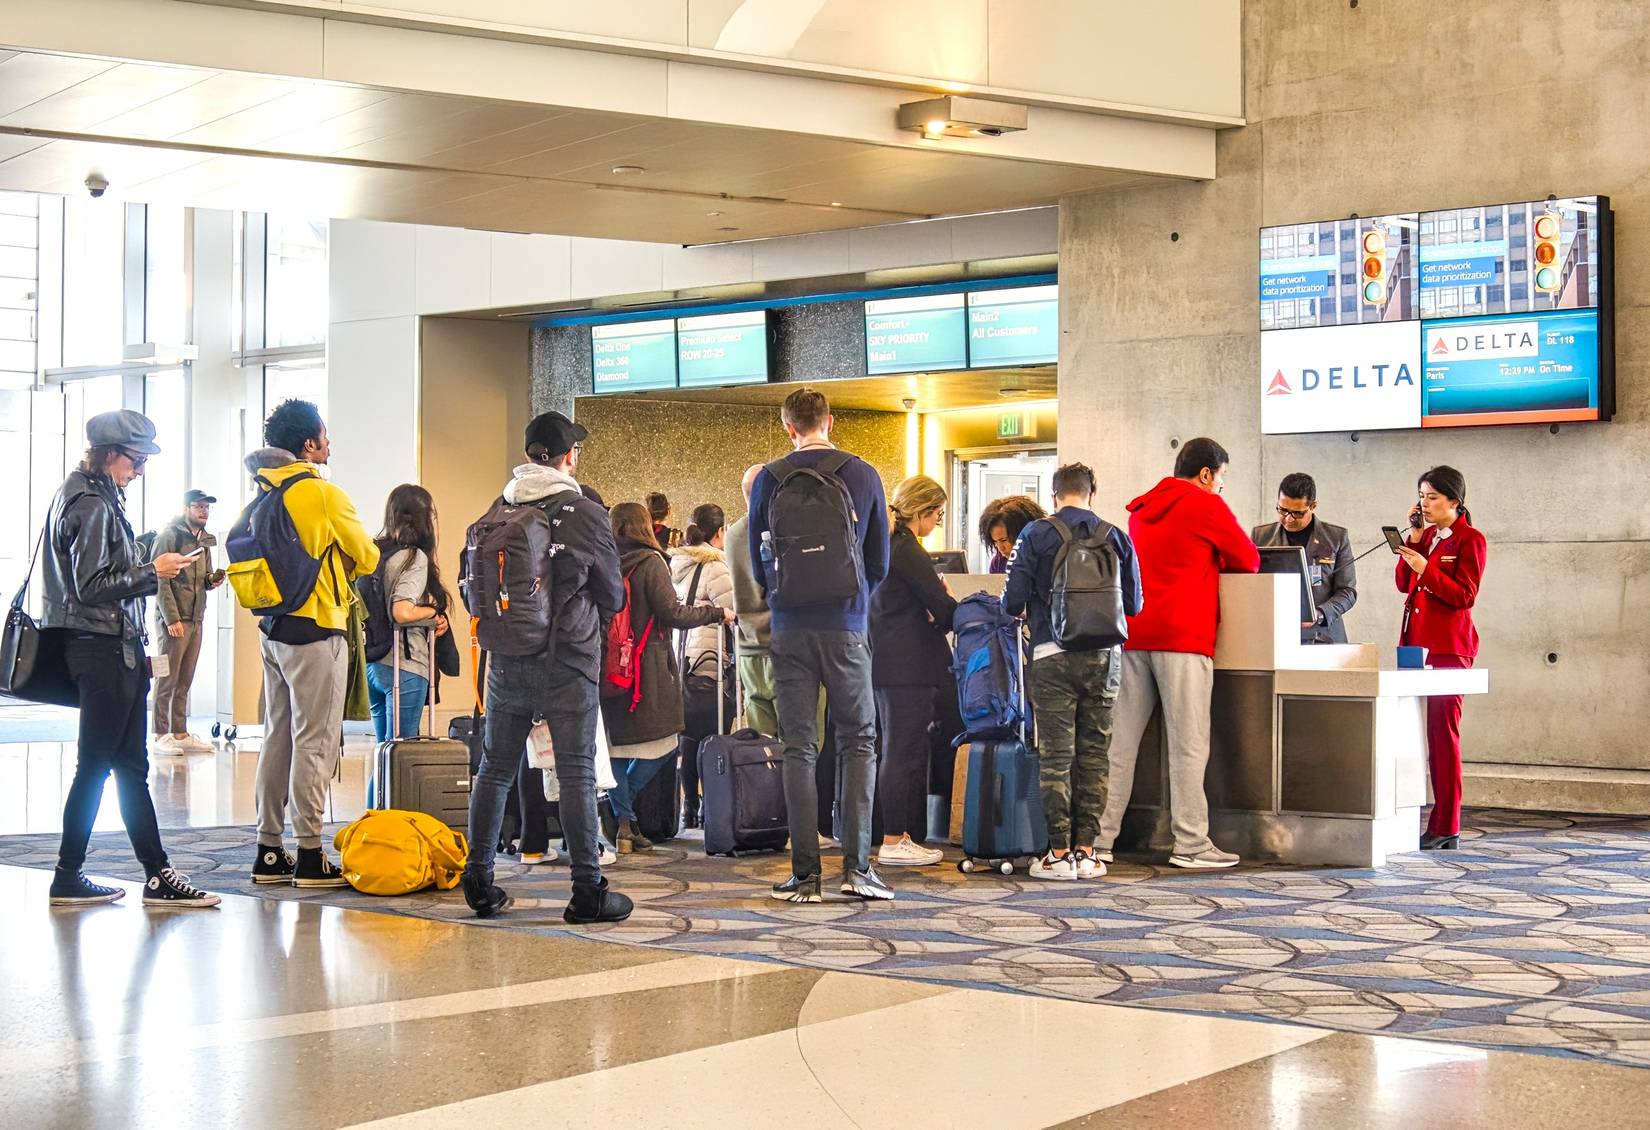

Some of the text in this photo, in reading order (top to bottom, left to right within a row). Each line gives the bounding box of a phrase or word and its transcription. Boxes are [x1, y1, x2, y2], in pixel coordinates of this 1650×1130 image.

[1422, 260, 1471, 273] Get network
[1262, 273, 1307, 286] Get network
[1422, 270, 1492, 285] data prioritization
[1262, 284, 1325, 297] data prioritization
[971, 327, 985, 338] All
[869, 331, 930, 346] SKY PRIORITY
[1456, 332, 1533, 351] DELTA
[1547, 335, 1575, 345] DL 118
[596, 343, 615, 353] Delta
[681, 350, 701, 360] ROW
[869, 350, 897, 361] Main1
[597, 357, 616, 368] Delta
[1523, 365, 1536, 375] PM
[1539, 364, 1574, 374] On Time
[597, 371, 630, 382] Diamond
[1302, 363, 1414, 391] DELTA
[1426, 371, 1445, 380] Paris
[1001, 416, 1019, 436] EXIT
